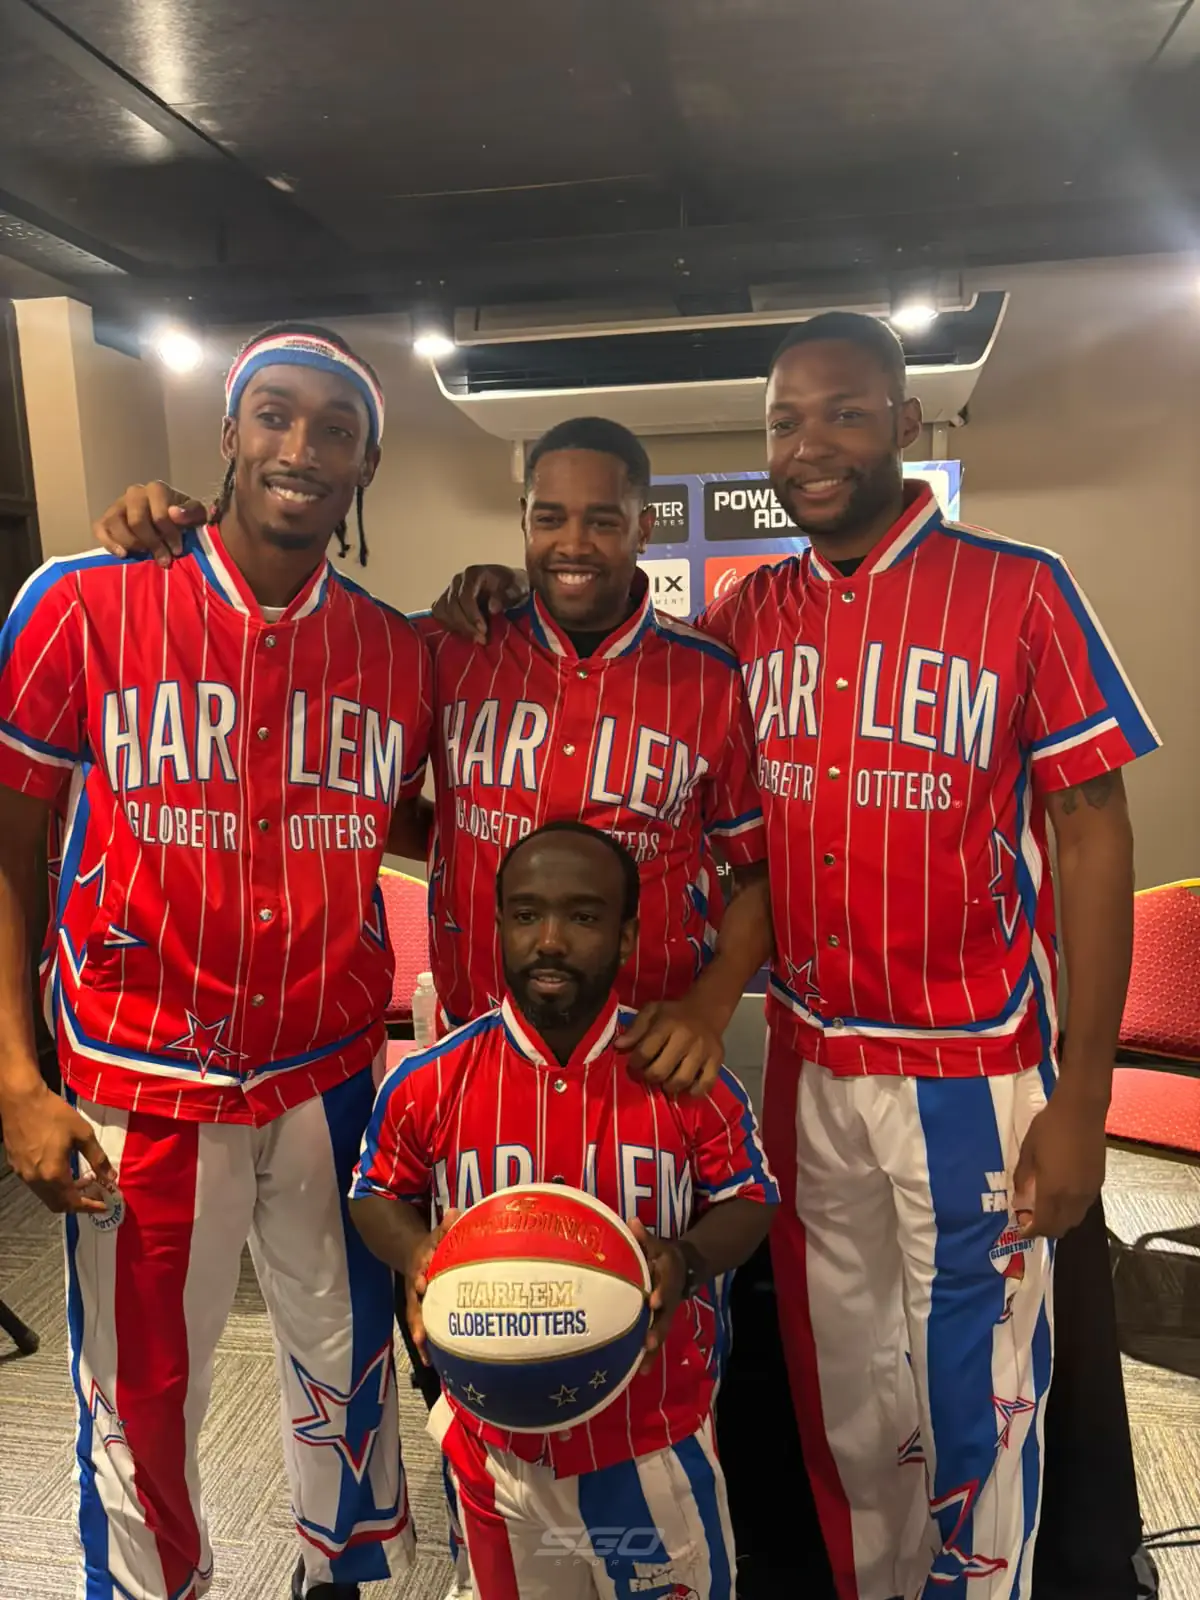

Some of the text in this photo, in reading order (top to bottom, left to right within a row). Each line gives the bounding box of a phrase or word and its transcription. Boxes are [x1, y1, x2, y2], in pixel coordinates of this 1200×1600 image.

[648, 501, 684, 518] TER
[456, 1280, 575, 1309] HARLEM
[448, 1310, 587, 1337] GLOBETROTTERS
